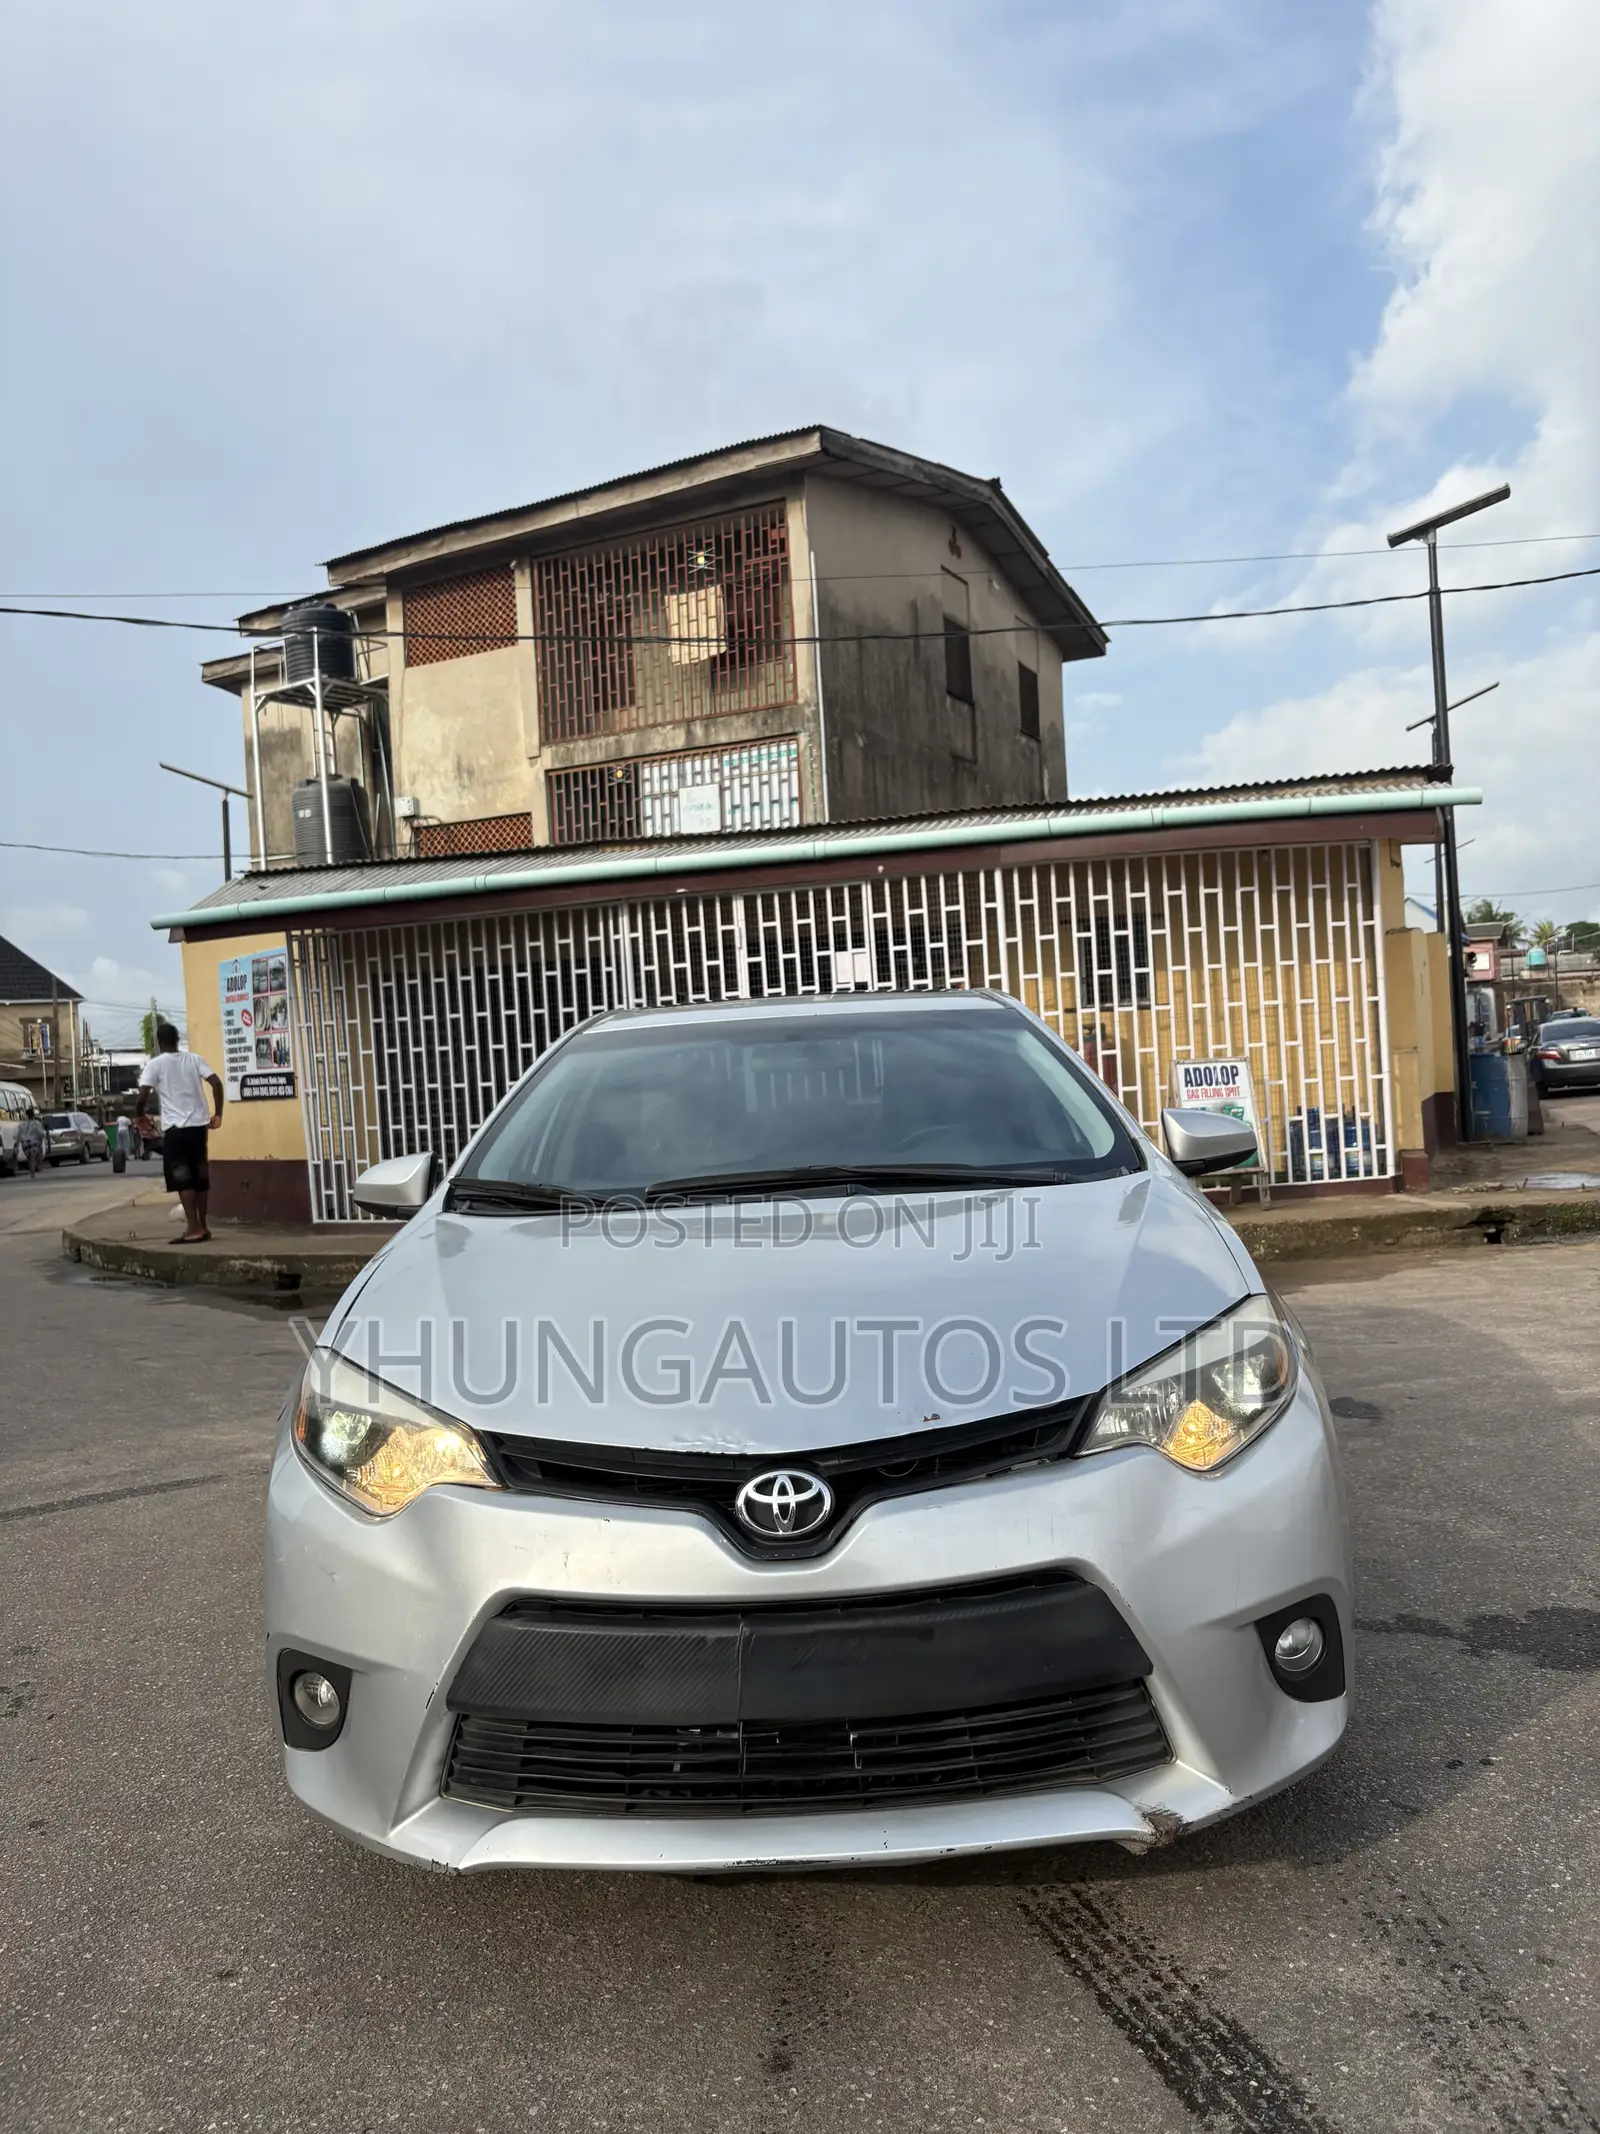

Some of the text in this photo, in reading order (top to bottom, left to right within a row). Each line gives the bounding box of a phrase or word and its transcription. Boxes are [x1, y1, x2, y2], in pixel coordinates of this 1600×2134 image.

[1184, 1065, 1239, 1088] ADOLOP
[1186, 1086, 1240, 1100] GAS FILLING SPOT
